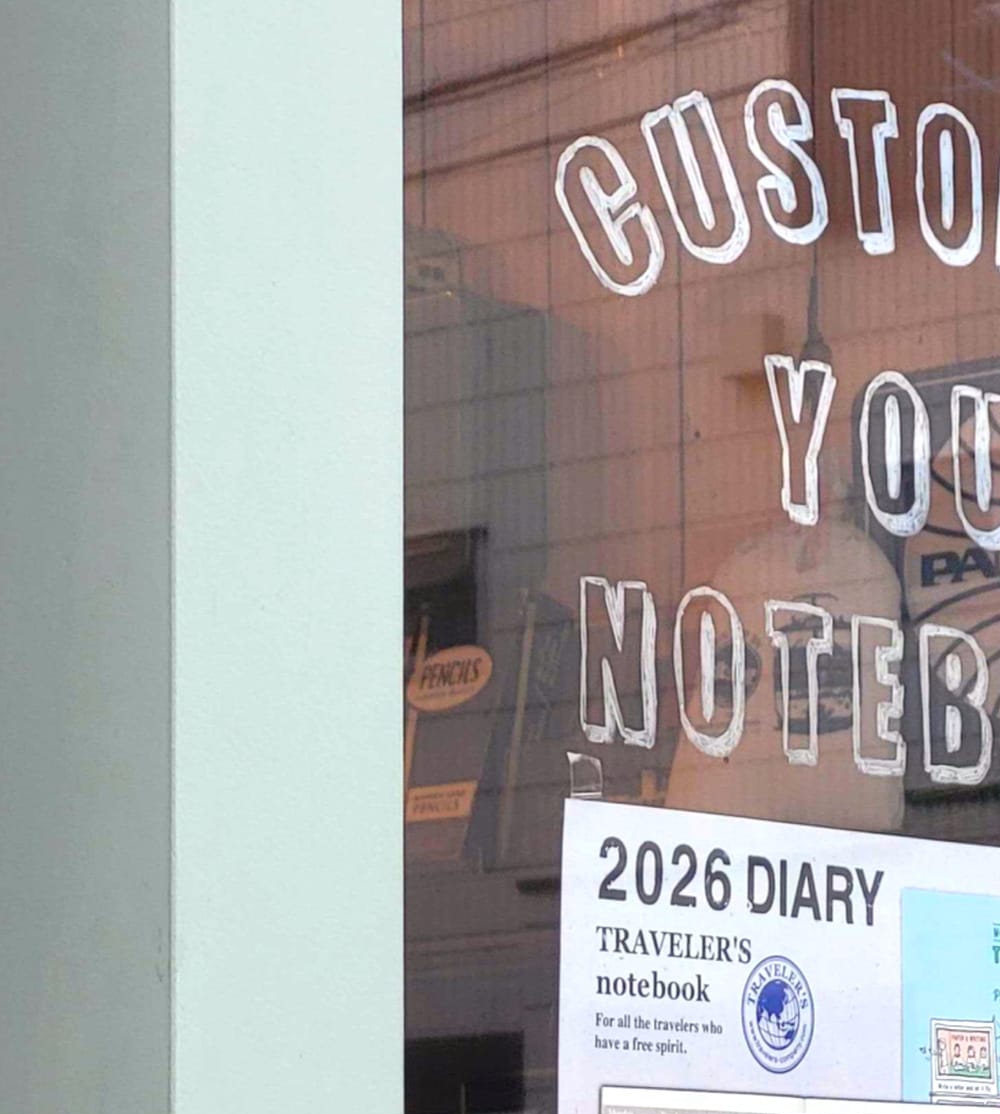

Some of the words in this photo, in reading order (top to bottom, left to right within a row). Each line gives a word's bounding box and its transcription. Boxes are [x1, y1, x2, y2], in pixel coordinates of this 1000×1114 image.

[598, 836, 732, 911] 2026
[747, 855, 885, 926] DIARY
[596, 926, 752, 964] TRAVELER'S
[596, 970, 711, 1003] notebook
[748, 963, 808, 1009] TRAVELER'S
[595, 1012, 614, 1027] For
[617, 1014, 631, 1029] all
[633, 1015, 650, 1030] the
[654, 1018, 699, 1033] travelers
[702, 1020, 723, 1034] who
[594, 1034, 620, 1050] have
[622, 1040, 629, 1050] a
[632, 1037, 653, 1052] free
[655, 1039, 688, 1056] spirit.
